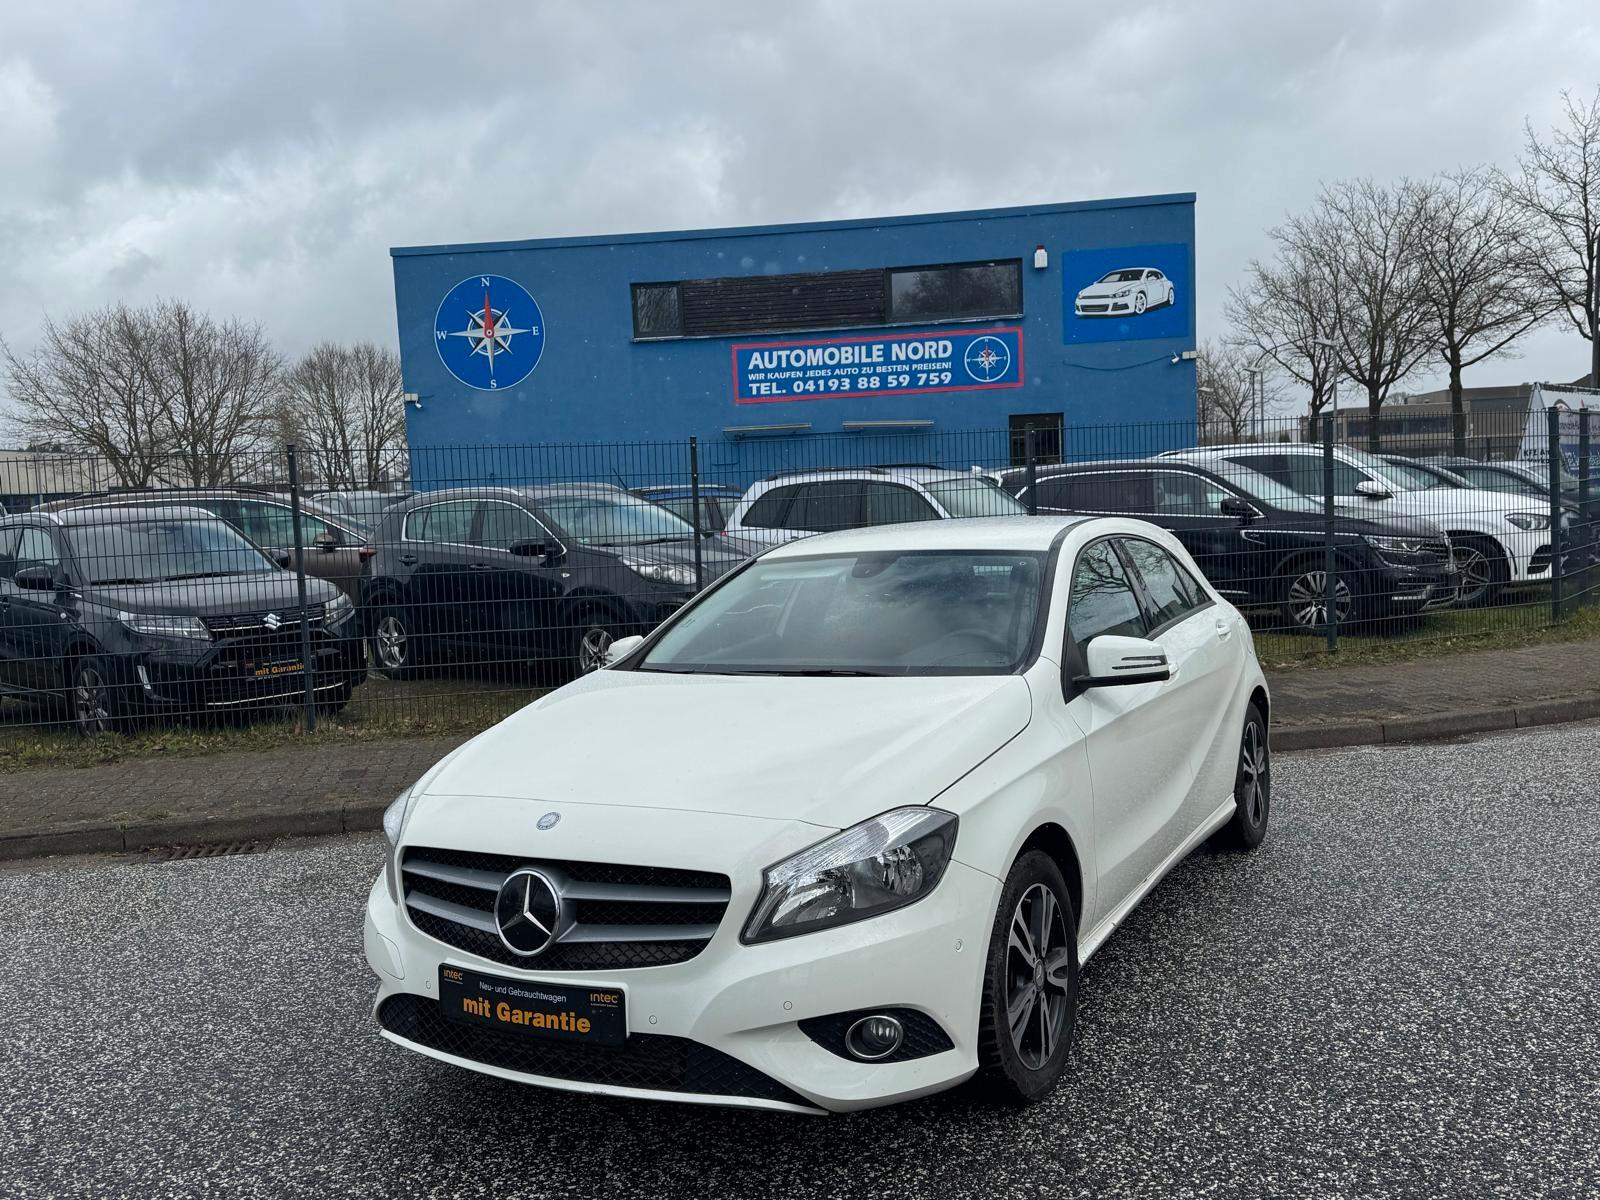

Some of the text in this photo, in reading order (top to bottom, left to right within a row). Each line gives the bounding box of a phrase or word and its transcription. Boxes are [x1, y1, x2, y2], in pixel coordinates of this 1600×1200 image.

[481, 277, 490, 287] N
[437, 331, 447, 340] W
[532, 326, 540, 336] E
[748, 340, 953, 370] AUTOMOBILE NORD
[767, 371, 803, 379] KAUFEN
[805, 369, 832, 377] JEDES
[834, 367, 859, 375] AUTO
[861, 366, 874, 374] ZU
[876, 364, 909, 373] BESTEN
[912, 361, 952, 371] PREISEN!
[490, 379, 497, 389] S
[748, 372, 952, 395] TEL. 04193 88 59 759
[255, 667, 269, 676] mit
[443, 969, 463, 981] intec
[479, 981, 567, 1004] Neu- und Gebrauchtwagen
[590, 992, 619, 1004] intec
[463, 996, 591, 1033] mit Garantie
